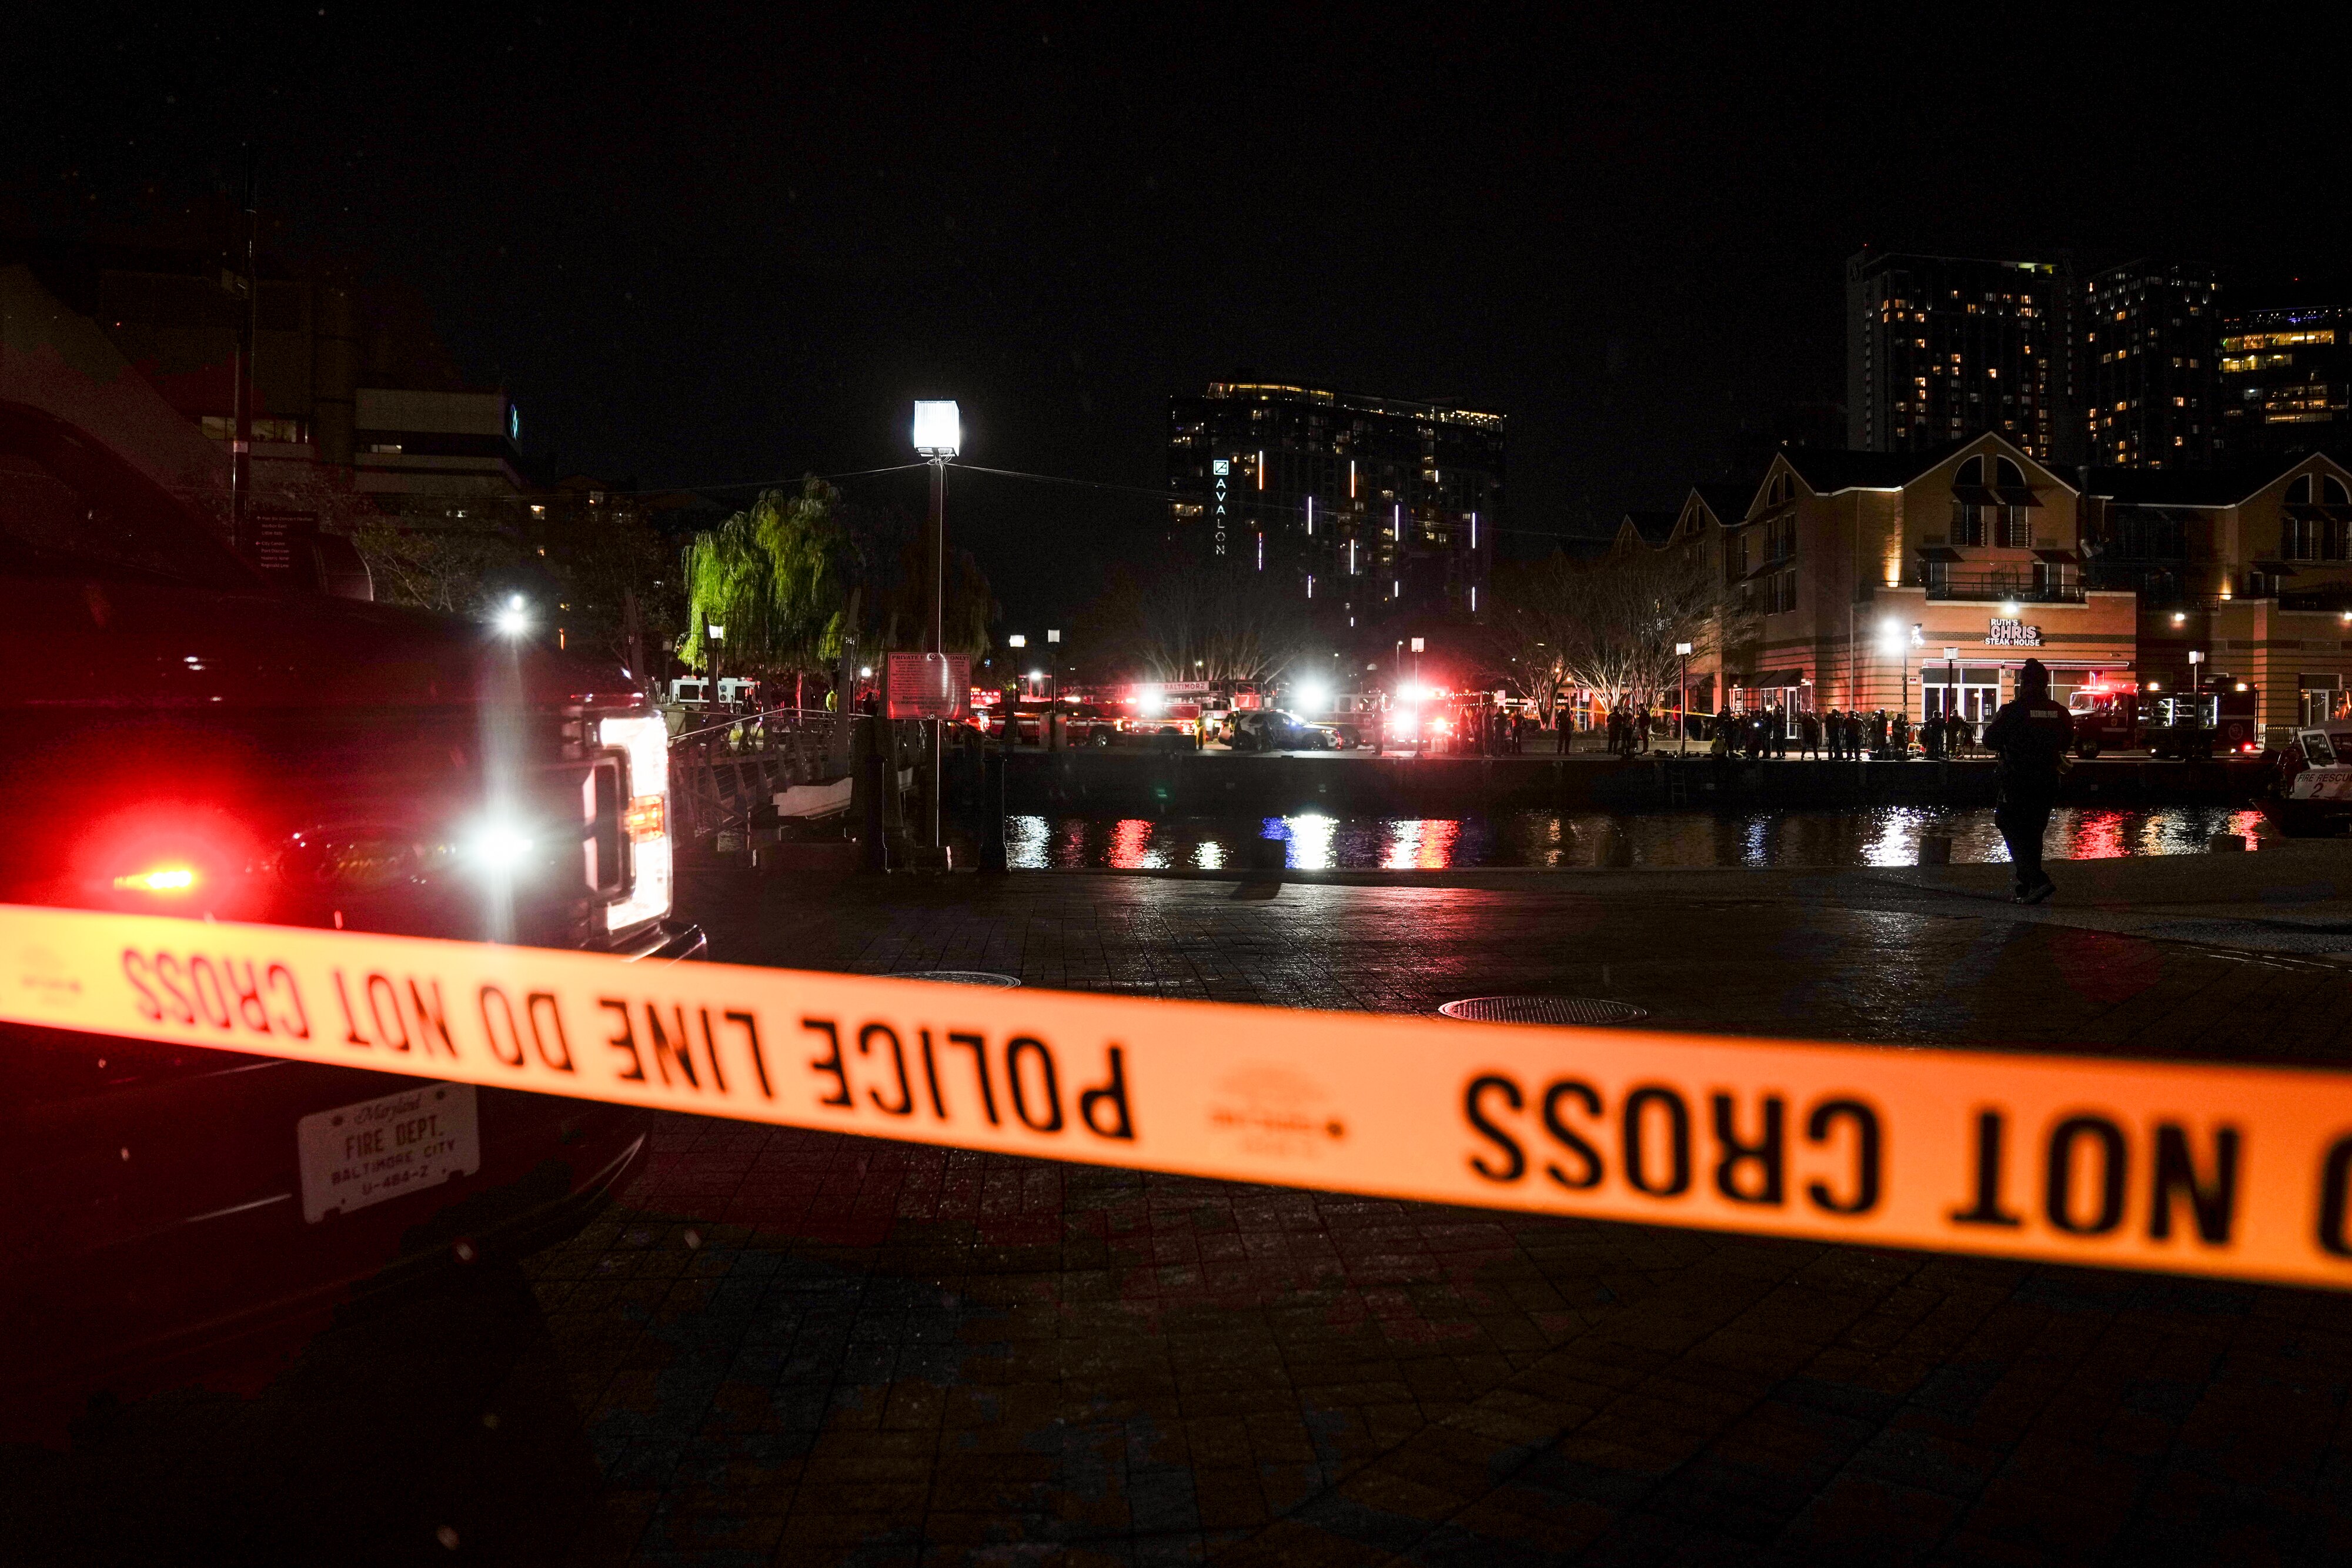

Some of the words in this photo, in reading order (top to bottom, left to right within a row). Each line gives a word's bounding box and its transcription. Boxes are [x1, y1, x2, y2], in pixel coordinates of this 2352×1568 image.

[1215, 478, 1227, 555] AVALON
[1990, 626, 2036, 639] CHRIS
[2297, 774, 2315, 782] FIRE
[2309, 783, 2324, 798] 2
[121, 948, 312, 1041] CROSS
[334, 971, 459, 1059] NOT
[478, 984, 577, 1075] DO
[597, 997, 775, 1100] LINE
[800, 1016, 1138, 1143] POLICE
[331, 1150, 413, 1186] BALTIMORE
[423, 1139, 455, 1158] CITY
[345, 1128, 383, 1160] FIRE
[395, 1115, 444, 1146] DEPT.
[1463, 1072, 1883, 1217] CROSS
[1947, 1107, 2242, 1249] NOT
